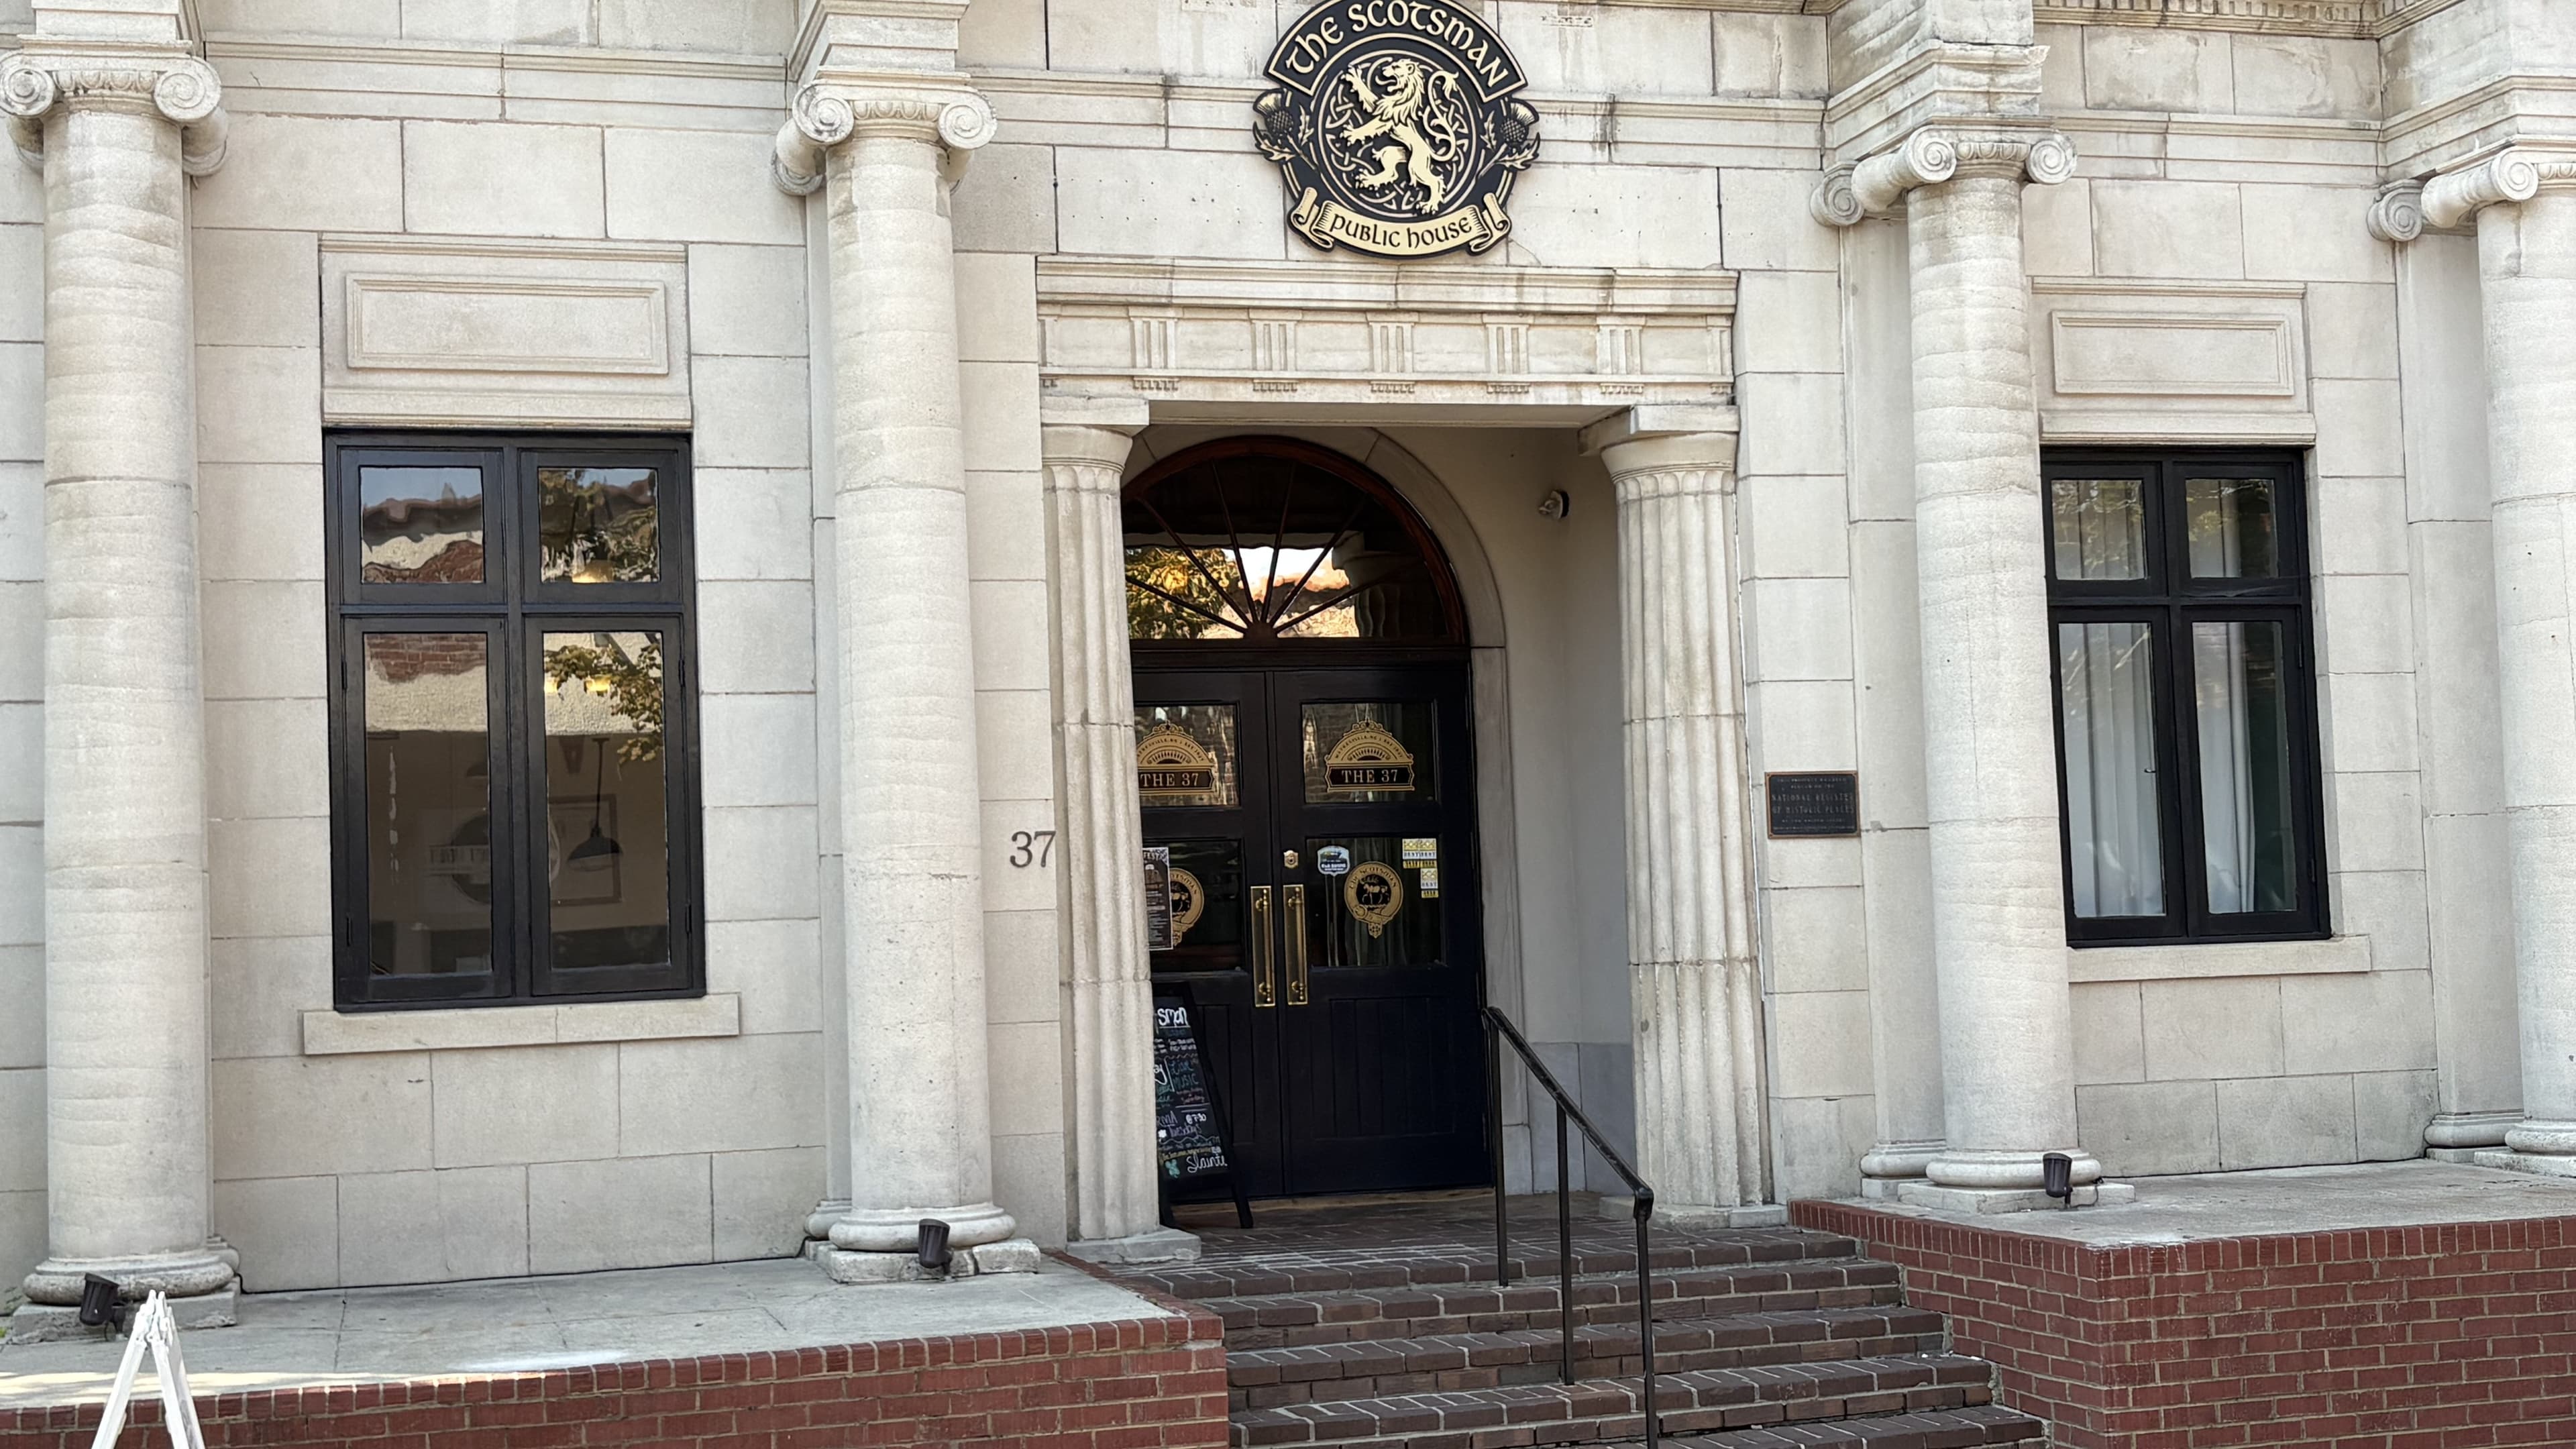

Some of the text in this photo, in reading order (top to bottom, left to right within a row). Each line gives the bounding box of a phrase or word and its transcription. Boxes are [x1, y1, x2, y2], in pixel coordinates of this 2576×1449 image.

[1348, 0, 1509, 88] SCOTSMAN
[1140, 772, 1199, 787] THE 37
[1341, 769, 1398, 784] THE 37
[1010, 830, 1057, 867] 37
